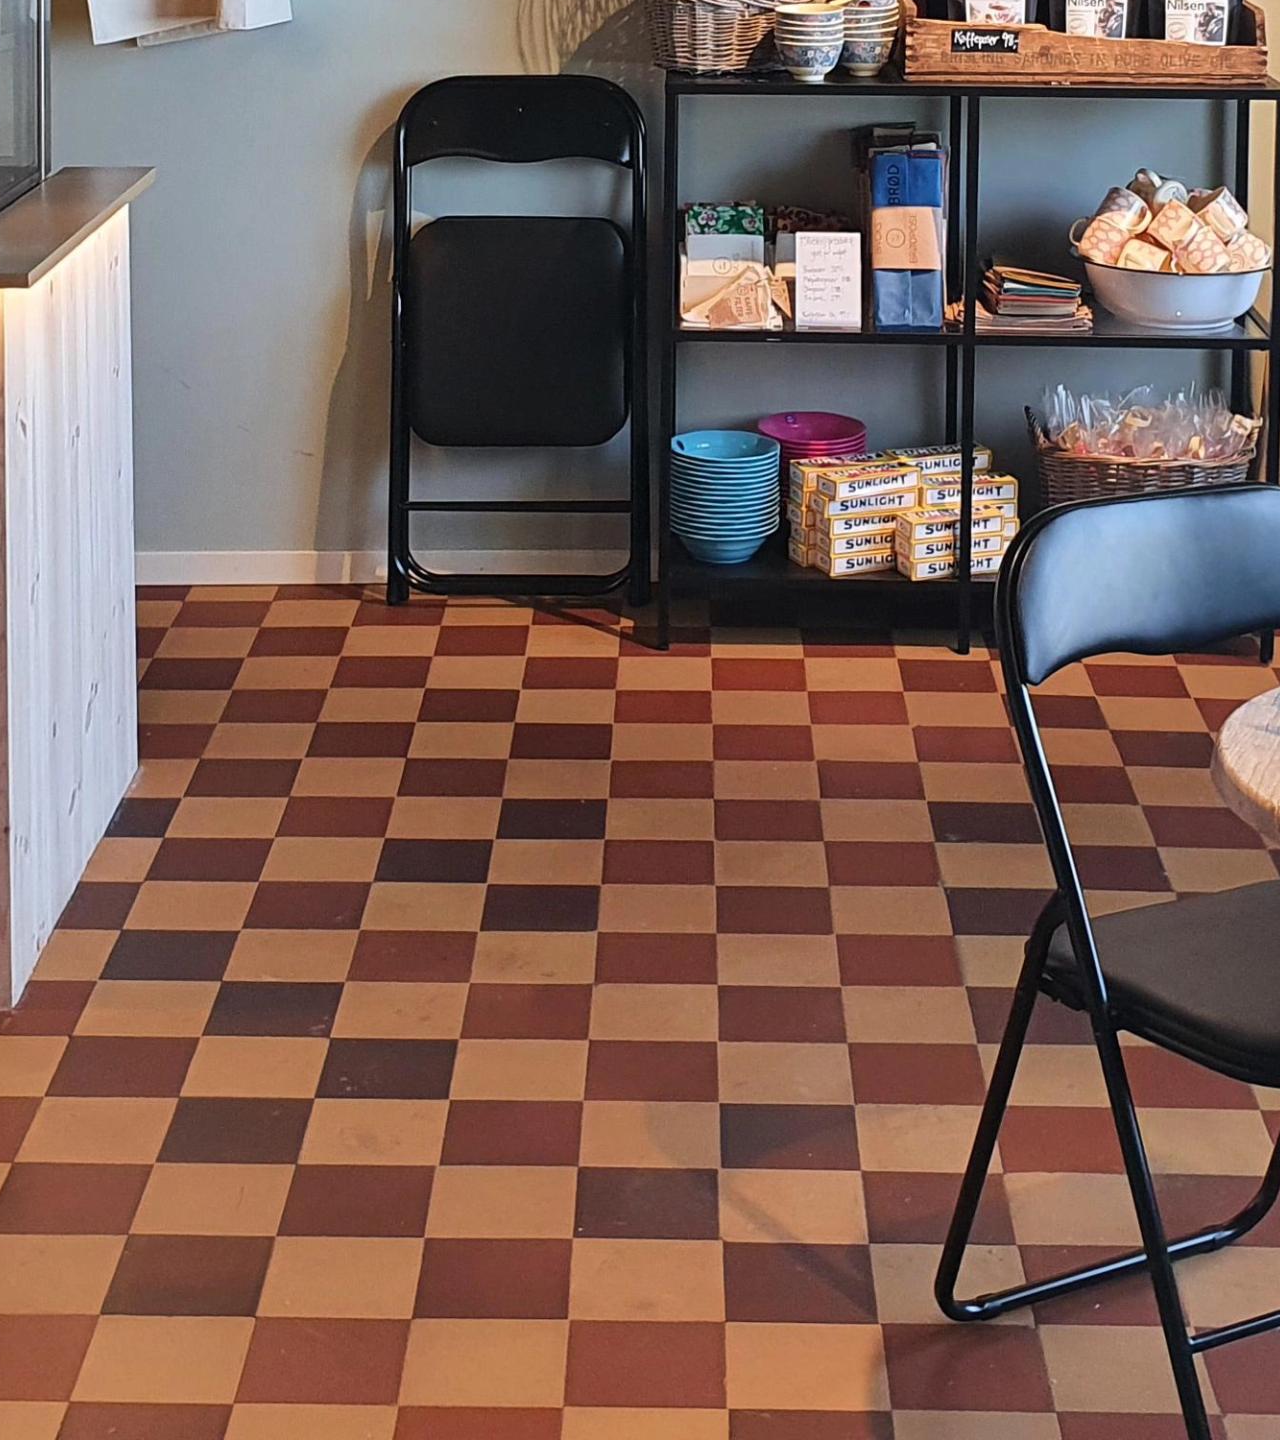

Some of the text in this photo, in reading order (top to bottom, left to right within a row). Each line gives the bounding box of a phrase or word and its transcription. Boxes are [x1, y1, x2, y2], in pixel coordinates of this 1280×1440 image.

[1167, 0, 1205, 11] Nilsen
[887, 163, 901, 206] BRØD
[895, 444, 961, 456] SUNLIGH
[848, 474, 908, 493] SUNLIGHT
[937, 486, 1003, 500] SUNIGHT
[840, 495, 905, 511] SUNLIGHT
[925, 519, 990, 535] SUNLHT
[845, 534, 895, 550] SUNLIG
[925, 539, 991, 555] SUNLHT
[845, 554, 895, 569] SUNLIG
